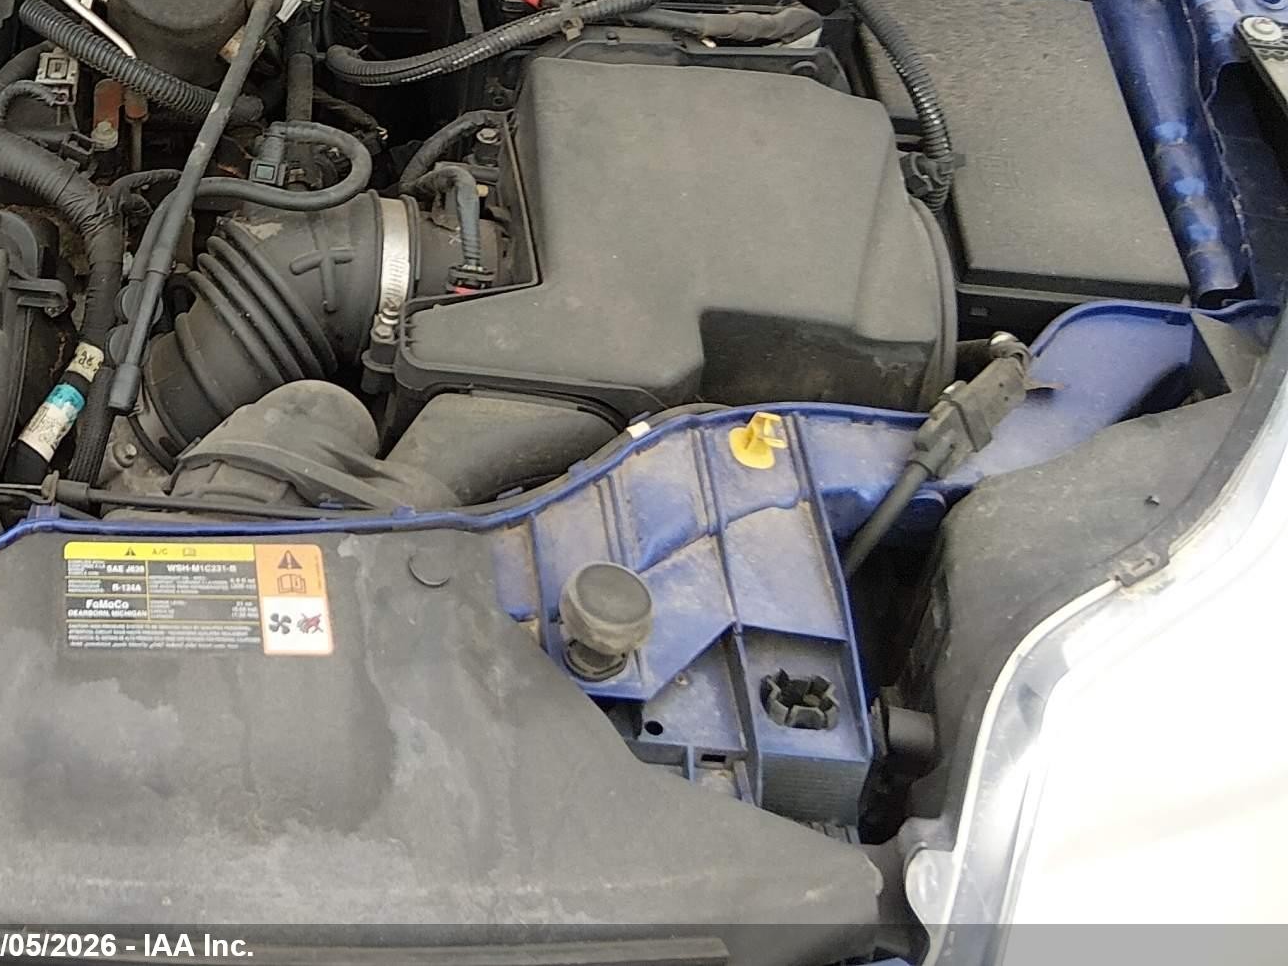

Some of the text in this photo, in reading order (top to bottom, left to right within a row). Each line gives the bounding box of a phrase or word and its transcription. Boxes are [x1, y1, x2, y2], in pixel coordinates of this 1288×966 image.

[151, 547, 168, 556] A/C
[106, 564, 124, 573] SAE
[85, 598, 130, 610] FoMoCo
[111, 609, 148, 618] MICHIGAN
